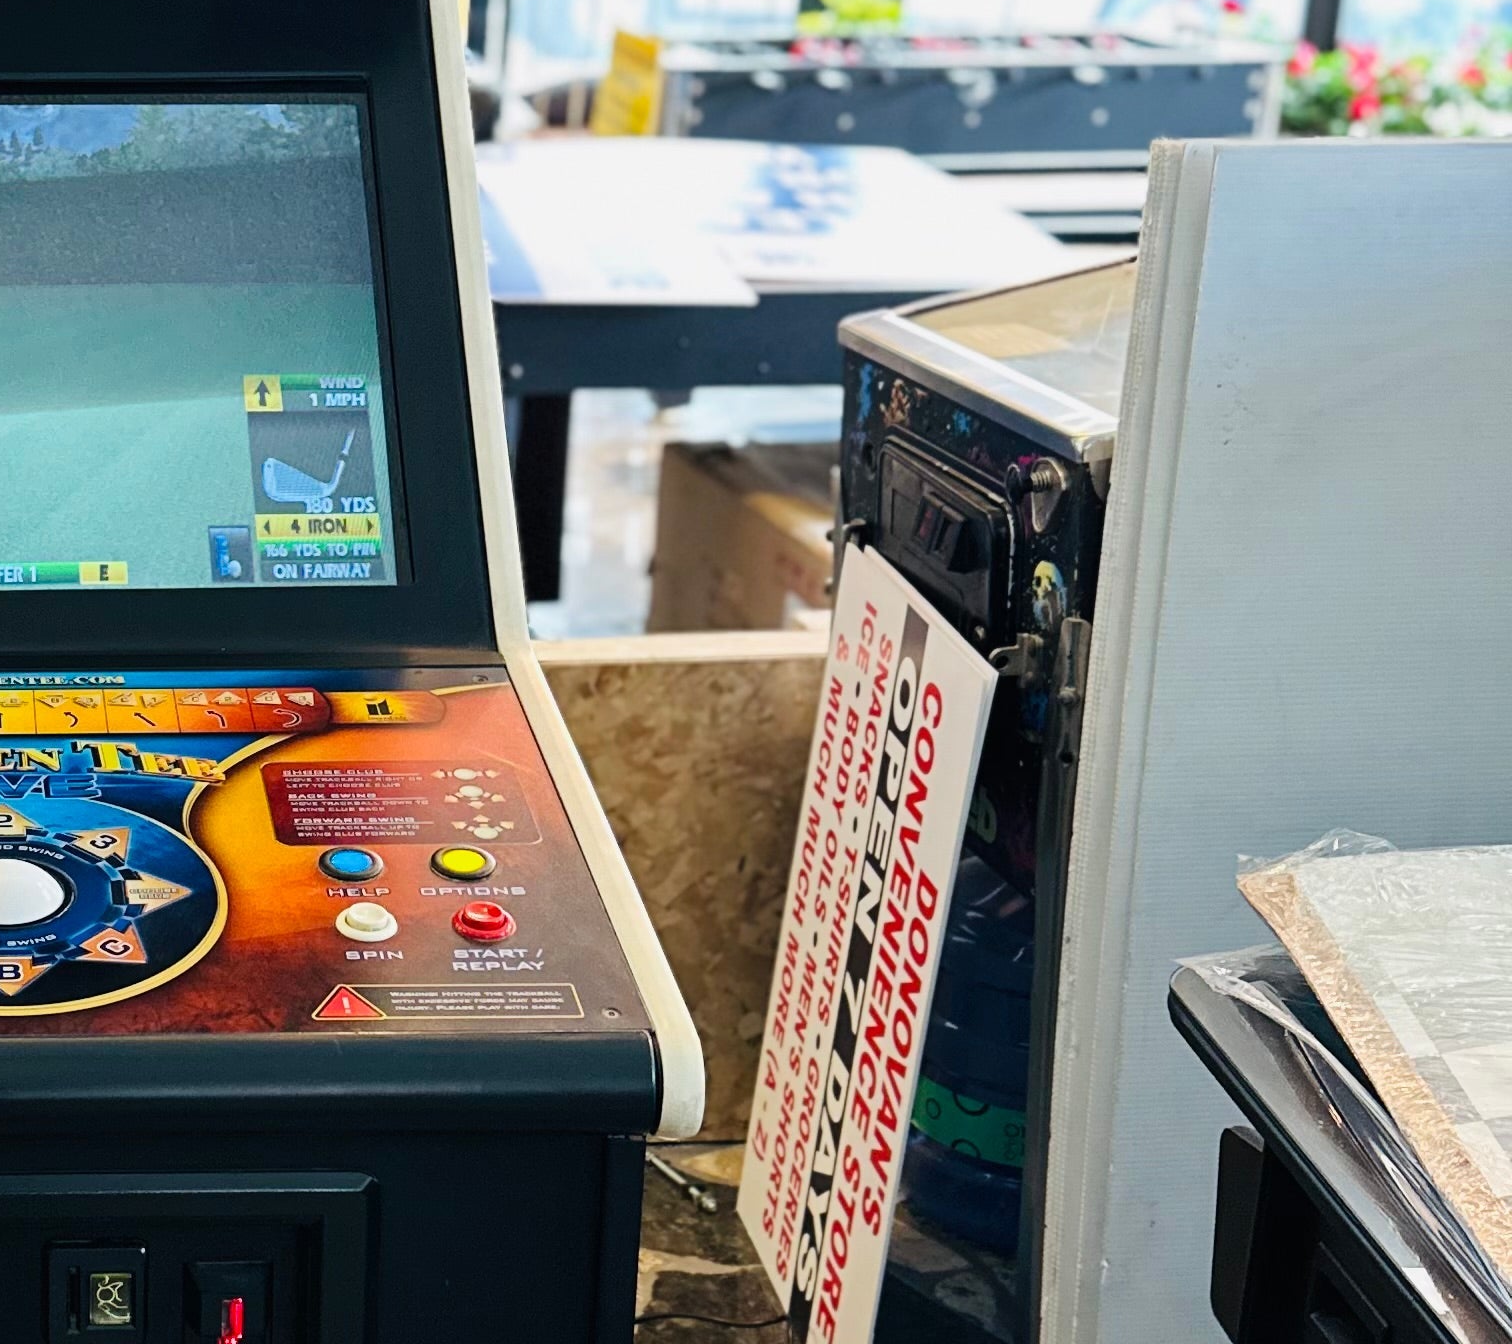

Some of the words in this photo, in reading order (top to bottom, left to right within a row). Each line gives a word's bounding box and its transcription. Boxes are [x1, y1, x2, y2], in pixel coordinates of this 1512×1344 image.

[309, 392, 318, 407] 1
[325, 392, 366, 406] MPH
[319, 376, 364, 389] WIND
[291, 519, 301, 534] 4
[308, 518, 347, 534] IRON
[304, 497, 333, 513] 180
[341, 496, 376, 513] YDS
[273, 564, 298, 579] ON
[303, 562, 371, 579] FAIRWAY
[295, 543, 321, 557] YDS
[326, 543, 347, 556] TO
[29, 564, 37, 582] 1
[835, 633, 850, 662] &
[856, 601, 878, 675] ICE
[813, 674, 843, 799] MUCH
[854, 633, 893, 809] SNACKS
[72, 741, 226, 784] TEE
[832, 705, 860, 823] BODY
[854, 656, 917, 945] OPEN
[18, 845, 66, 860] SWING
[89, 834, 118, 850] 3
[792, 805, 821, 928] MUCH
[814, 829, 838, 923] OILS
[326, 887, 391, 897] HELP
[419, 886, 527, 897] OPTIONS
[850, 682, 943, 1143] CONVENIENCE
[6, 933, 57, 947] SWING
[98, 938, 130, 957] C
[345, 950, 404, 960] SPIN
[453, 948, 529, 959] START
[818, 845, 858, 1027] T-SHIRTS
[452, 960, 545, 972] REPLAY
[772, 931, 799, 1049] MORE
[843, 970, 865, 1036] 7
[789, 952, 817, 1076] MEN'S
[862, 869, 939, 1237] DONOVAN'S
[762, 1081, 796, 1239] SHORTS
[776, 1057, 820, 1282] GROCERIES
[796, 1049, 850, 1302] DAYS
